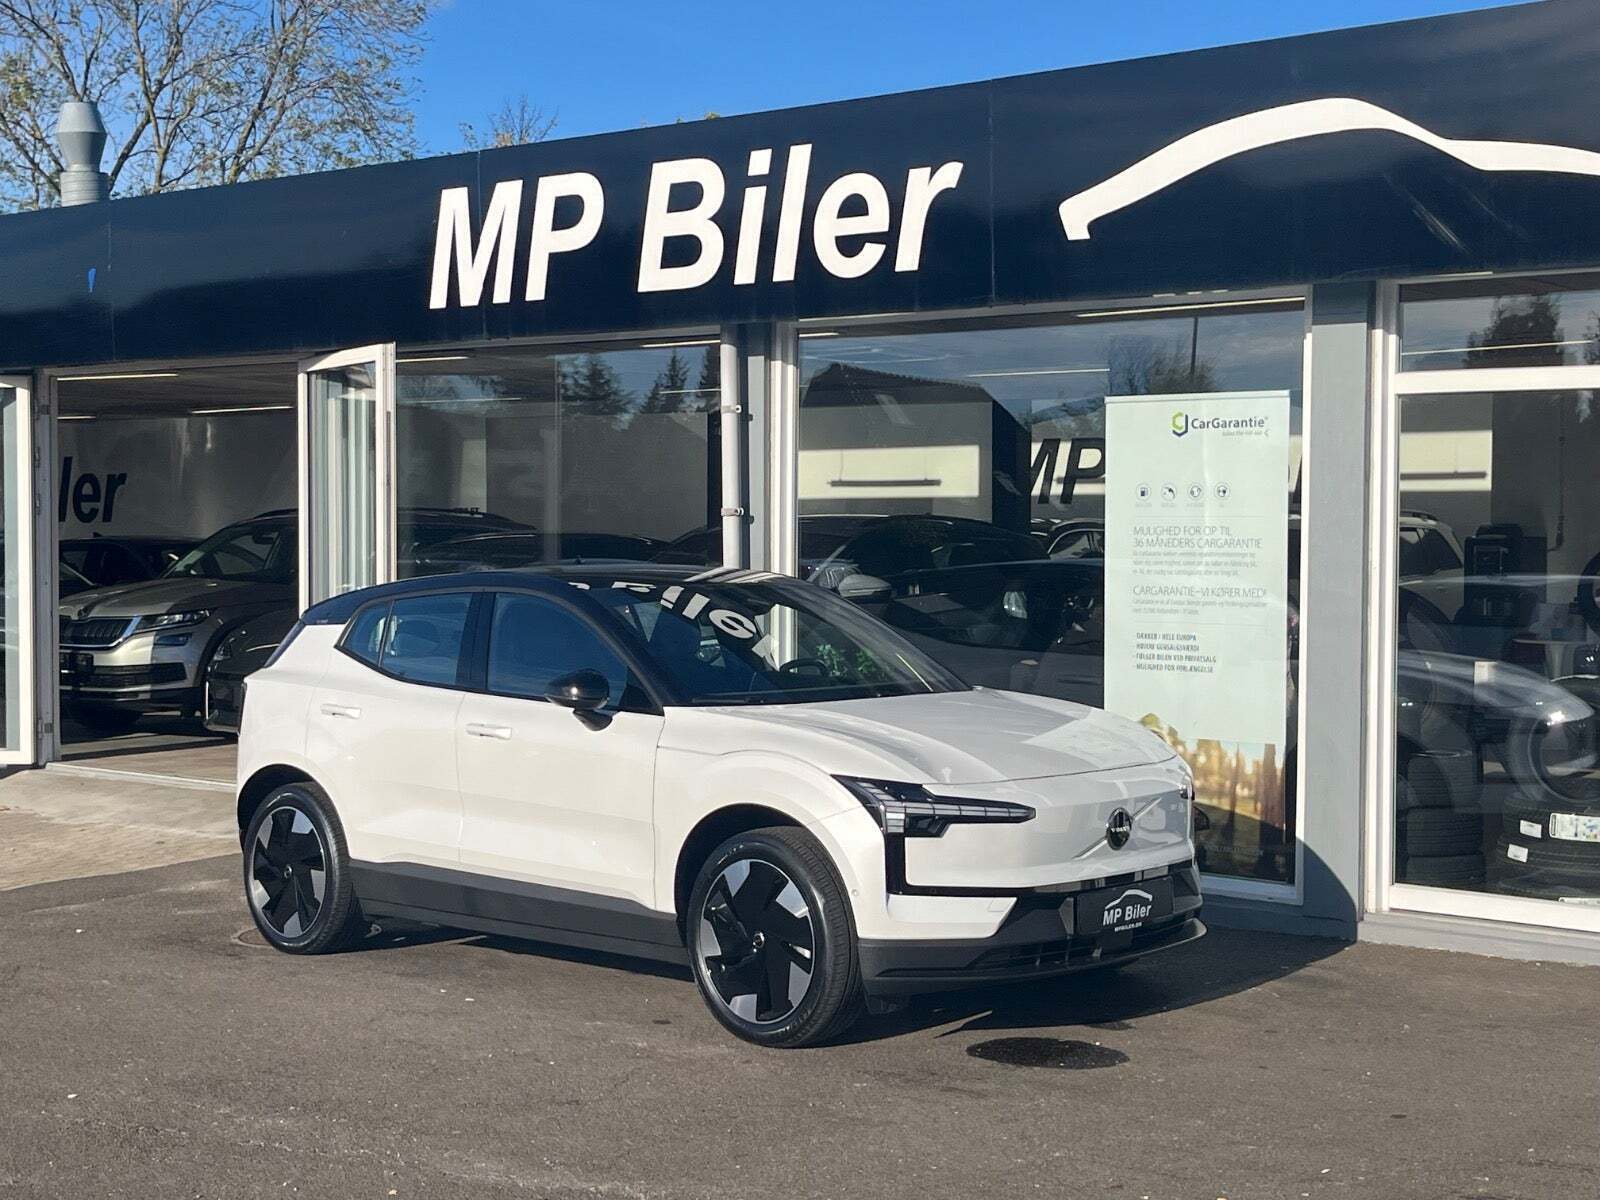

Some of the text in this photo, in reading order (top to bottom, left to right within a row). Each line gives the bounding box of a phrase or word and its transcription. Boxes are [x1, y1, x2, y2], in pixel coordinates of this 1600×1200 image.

[429, 143, 964, 310] MP Biler
[1191, 417, 1265, 429] CarGarantie
[1133, 525, 1232, 537] MULIGHED FOR OP TIL
[1146, 536, 1196, 549] MÅNEDERS
[1197, 537, 1263, 549] CARGARANTIE
[1103, 903, 1152, 926] MP Biler
